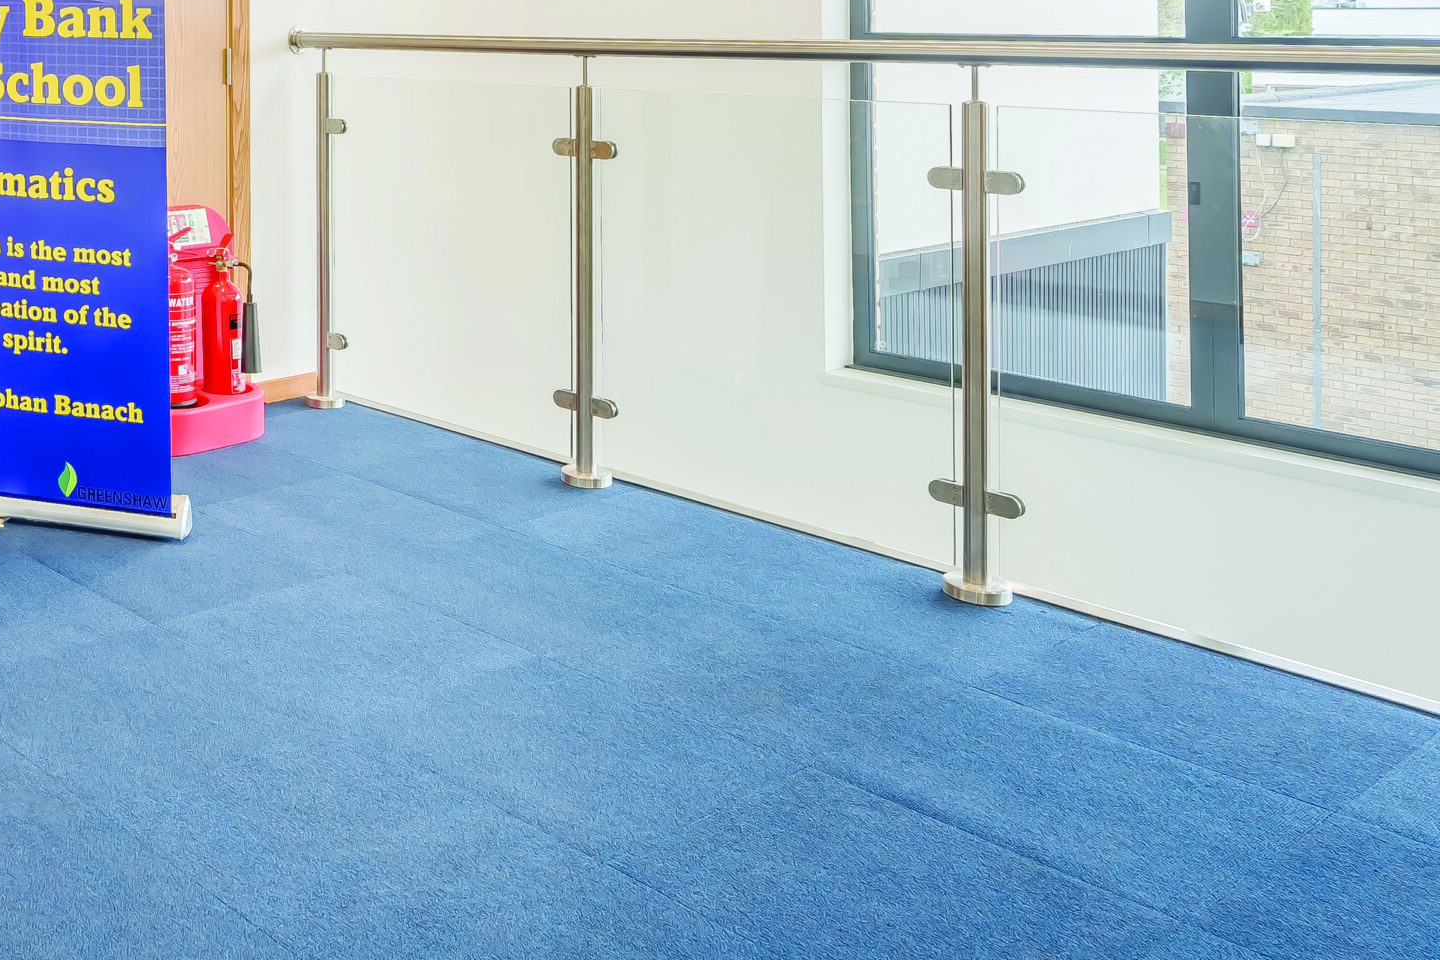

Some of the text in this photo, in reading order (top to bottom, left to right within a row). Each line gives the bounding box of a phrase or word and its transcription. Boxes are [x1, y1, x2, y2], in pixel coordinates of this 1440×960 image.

[6, 236, 25, 258] is
[30, 240, 67, 263] the
[73, 246, 132, 267] most
[42, 275, 100, 296] most
[168, 296, 194, 308] WATER
[63, 305, 90, 326] of
[93, 306, 133, 330] the
[3, 331, 69, 355] spirit.
[54, 394, 144, 424] Banach
[77, 487, 168, 510] GREENSHAW
